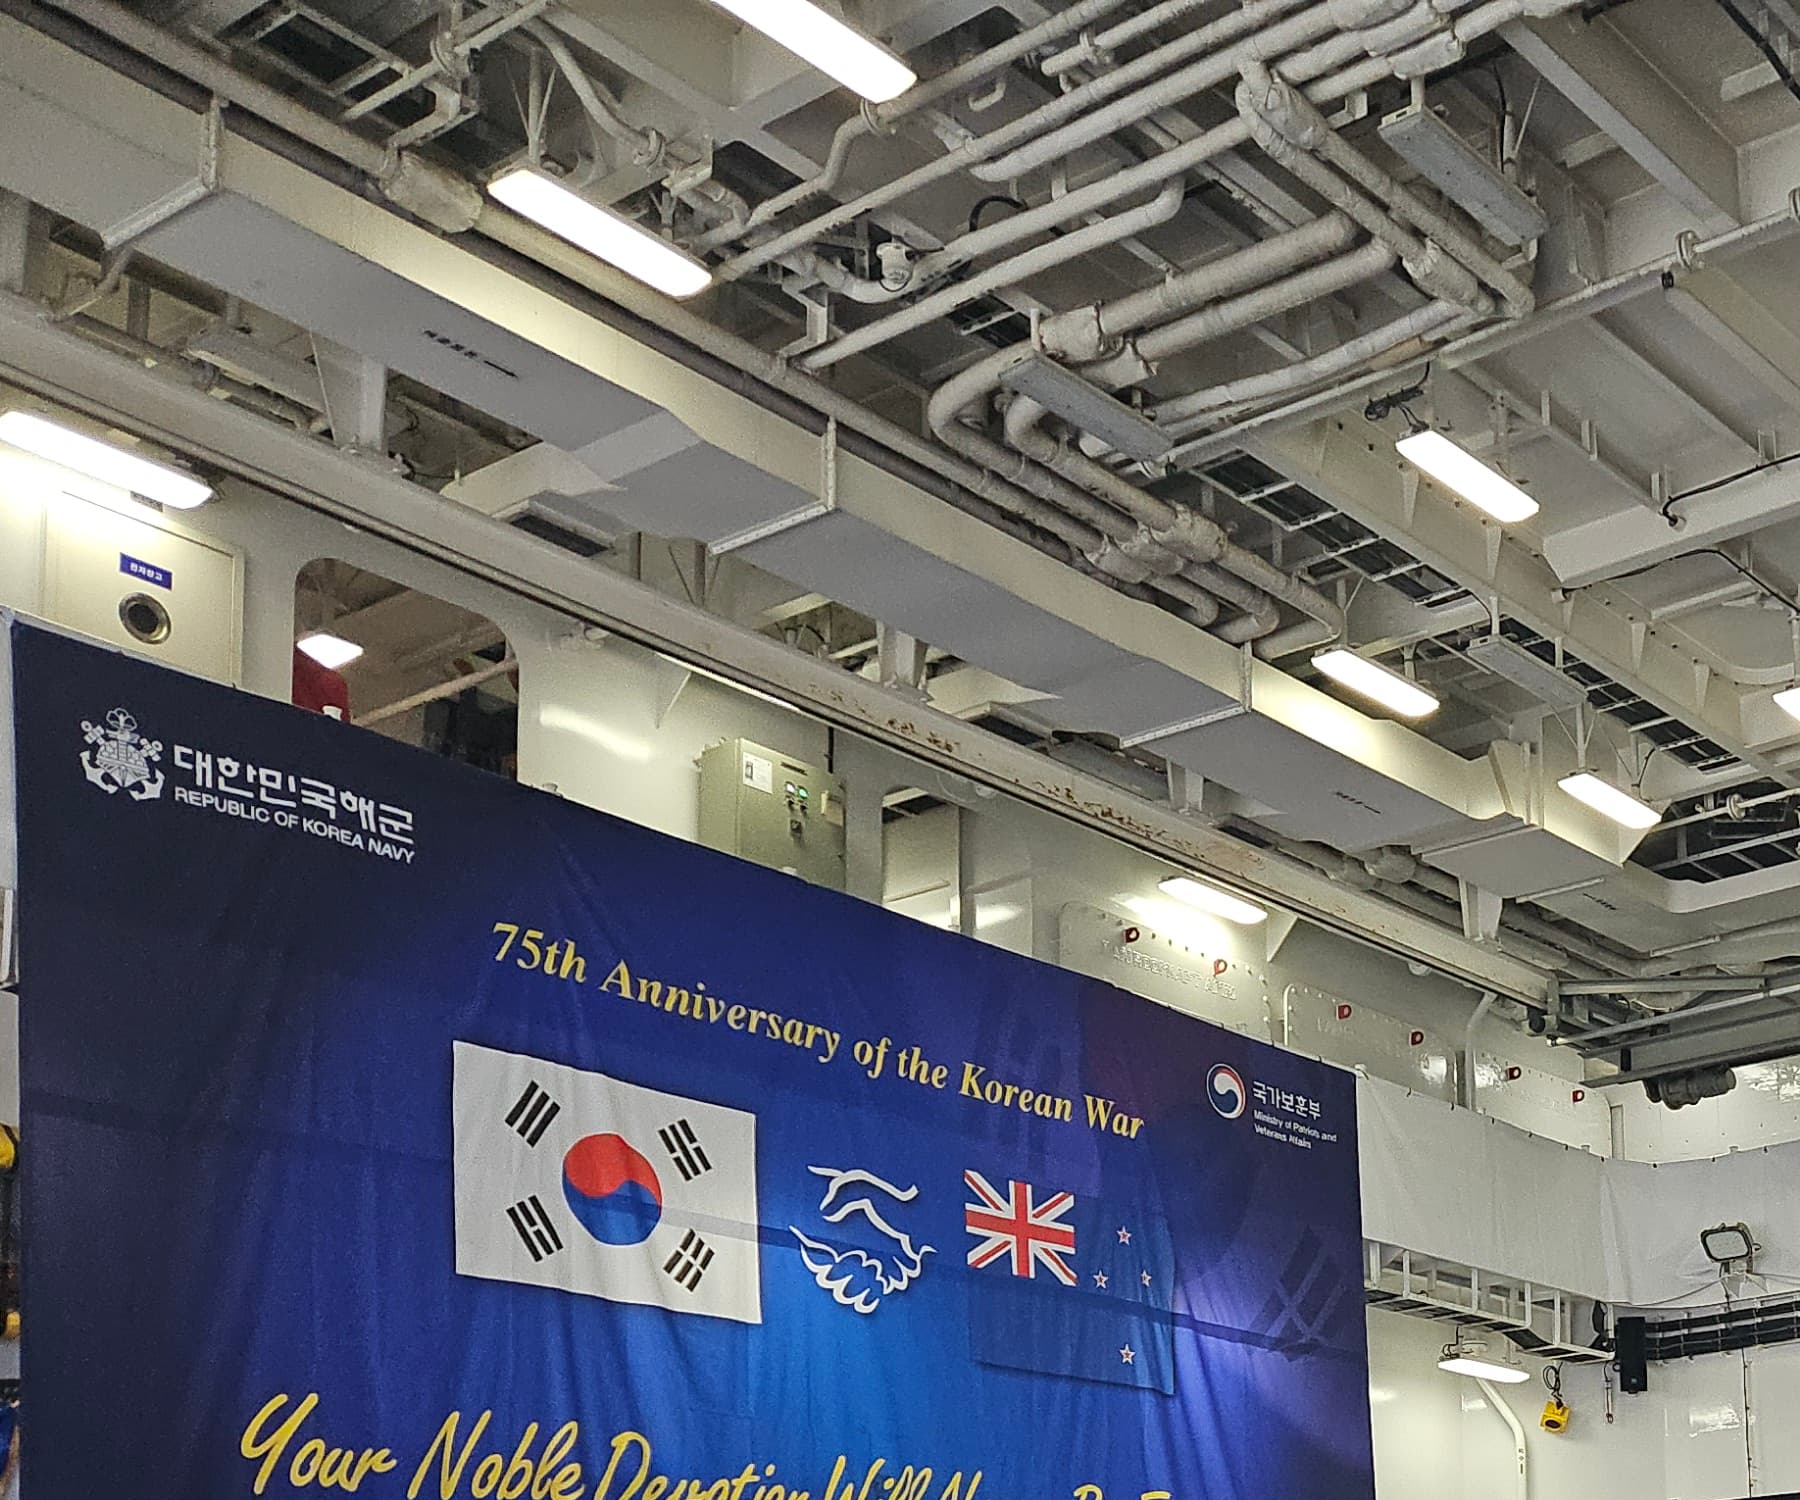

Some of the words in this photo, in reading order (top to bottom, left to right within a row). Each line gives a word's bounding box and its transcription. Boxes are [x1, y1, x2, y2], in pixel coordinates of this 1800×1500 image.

[174, 744, 414, 845] 대한민국해군
[174, 786, 270, 823] REPUBLIC
[274, 811, 299, 829] OF
[303, 817, 364, 850] KOREA
[368, 837, 415, 864] NAVY
[492, 922, 587, 983] 75th
[599, 959, 840, 1063] Anniversary
[853, 1036, 892, 1079] of
[898, 1046, 948, 1089] the
[959, 1060, 1073, 1123] Korean
[1083, 1093, 1145, 1140] War
[1252, 1080, 1321, 1120] 국가보훈부
[1253, 1109, 1283, 1129] Ministry
[1285, 1120, 1292, 1129] of
[1292, 1122, 1320, 1139] Patriots
[1321, 1132, 1337, 1142] and
[1254, 1123, 1288, 1142] Veterans
[239, 1392, 397, 1496] Your
